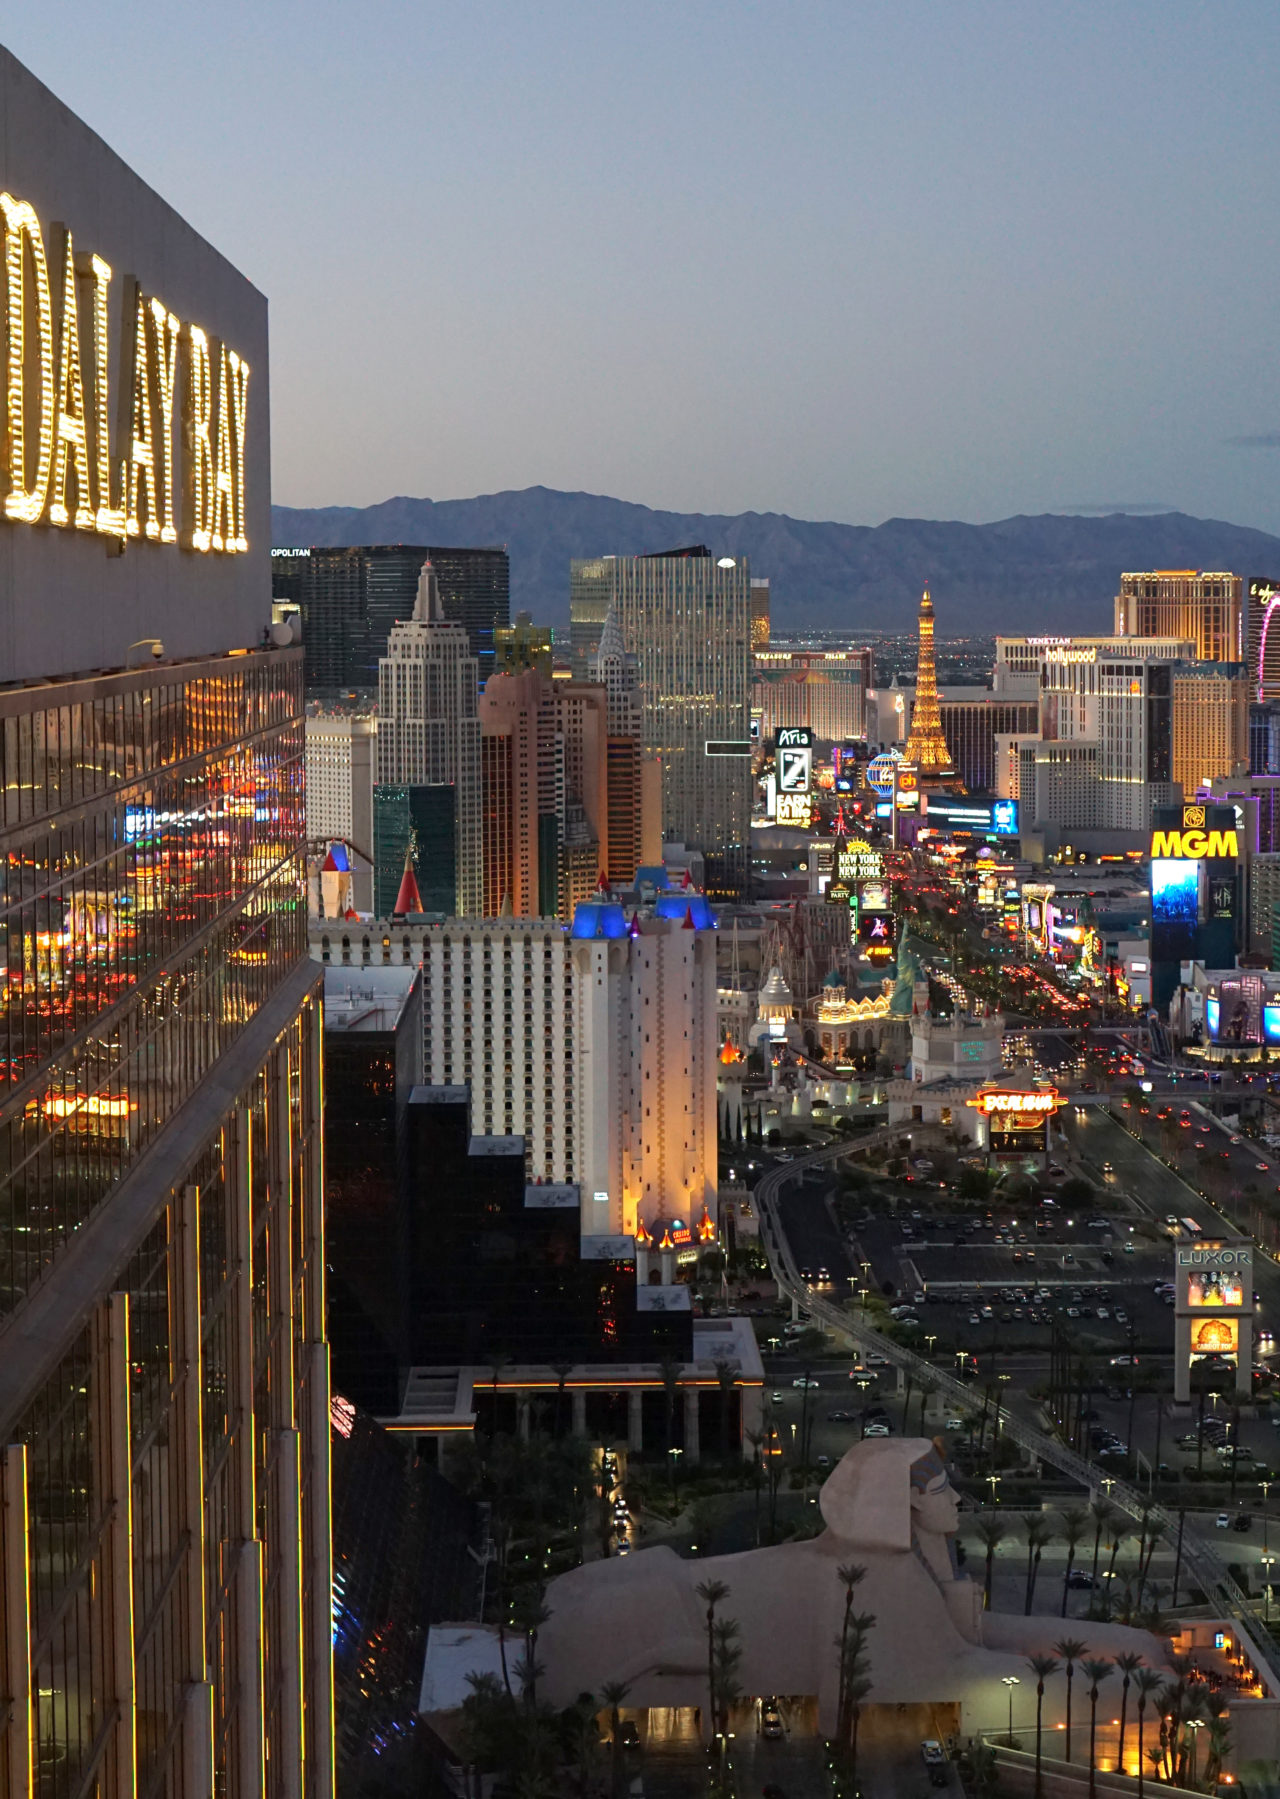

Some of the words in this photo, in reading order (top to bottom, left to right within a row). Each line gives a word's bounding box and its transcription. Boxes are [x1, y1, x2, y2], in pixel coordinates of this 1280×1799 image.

[0, 192, 177, 545] DALAY
[190, 323, 250, 554] BAY
[271, 548, 311, 557] OPOLITAN
[1027, 637, 1071, 645] VENETIAN
[1045, 646, 1096, 667] hollywood
[779, 729, 809, 746] Aria
[776, 794, 812, 807] EARN
[776, 805, 790, 818] M
[1151, 830, 1239, 858] MGM
[838, 854, 858, 864] NEW
[858, 854, 881, 864] YORK
[838, 866, 858, 876] NEW
[858, 866, 881, 876] YORK
[1178, 1250, 1252, 1266] LUXOR
[1196, 1343, 1220, 1351] CARROT
[1221, 1343, 1233, 1351] TOP
